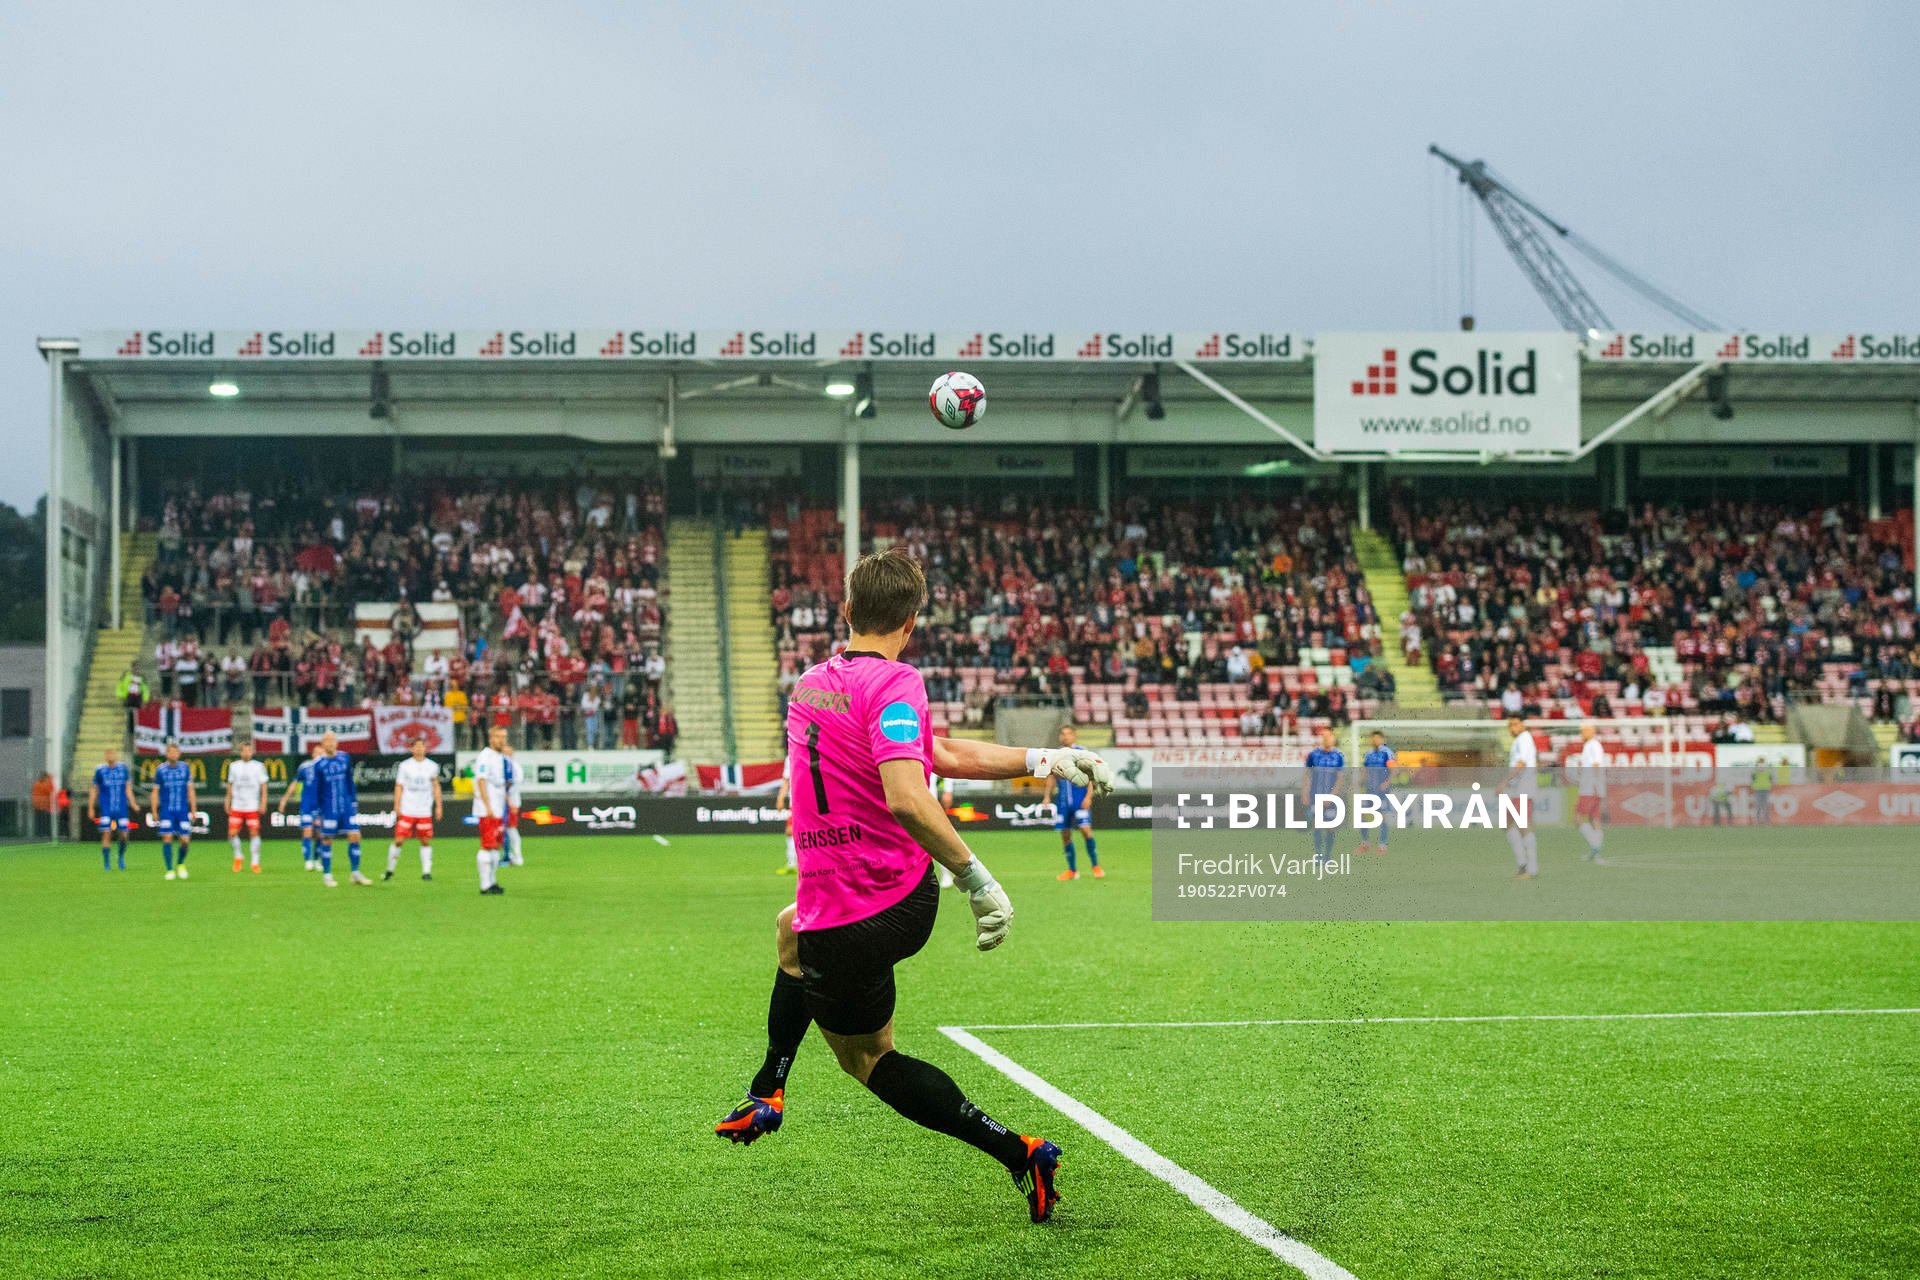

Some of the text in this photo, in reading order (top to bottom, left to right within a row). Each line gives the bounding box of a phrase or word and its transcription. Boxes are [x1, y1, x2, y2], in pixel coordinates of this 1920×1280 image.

[147, 332, 214, 356] Solid
[268, 332, 335, 356] Solid
[389, 332, 455, 356] Solid
[510, 332, 576, 356] Solid
[630, 332, 696, 356] Solid
[750, 332, 816, 356] Solid
[869, 333, 935, 357] Solid
[989, 333, 1054, 357] Solid
[1107, 334, 1172, 357] Solid
[1226, 334, 1290, 357] Solid
[1629, 335, 1694, 359] Solid
[1745, 335, 1809, 359] Solid
[1409, 349, 1537, 396] Solid
[1360, 411, 1531, 435] www.solid.no
[804, 721, 831, 815] 1
[981, 1115, 1008, 1136] umbro
